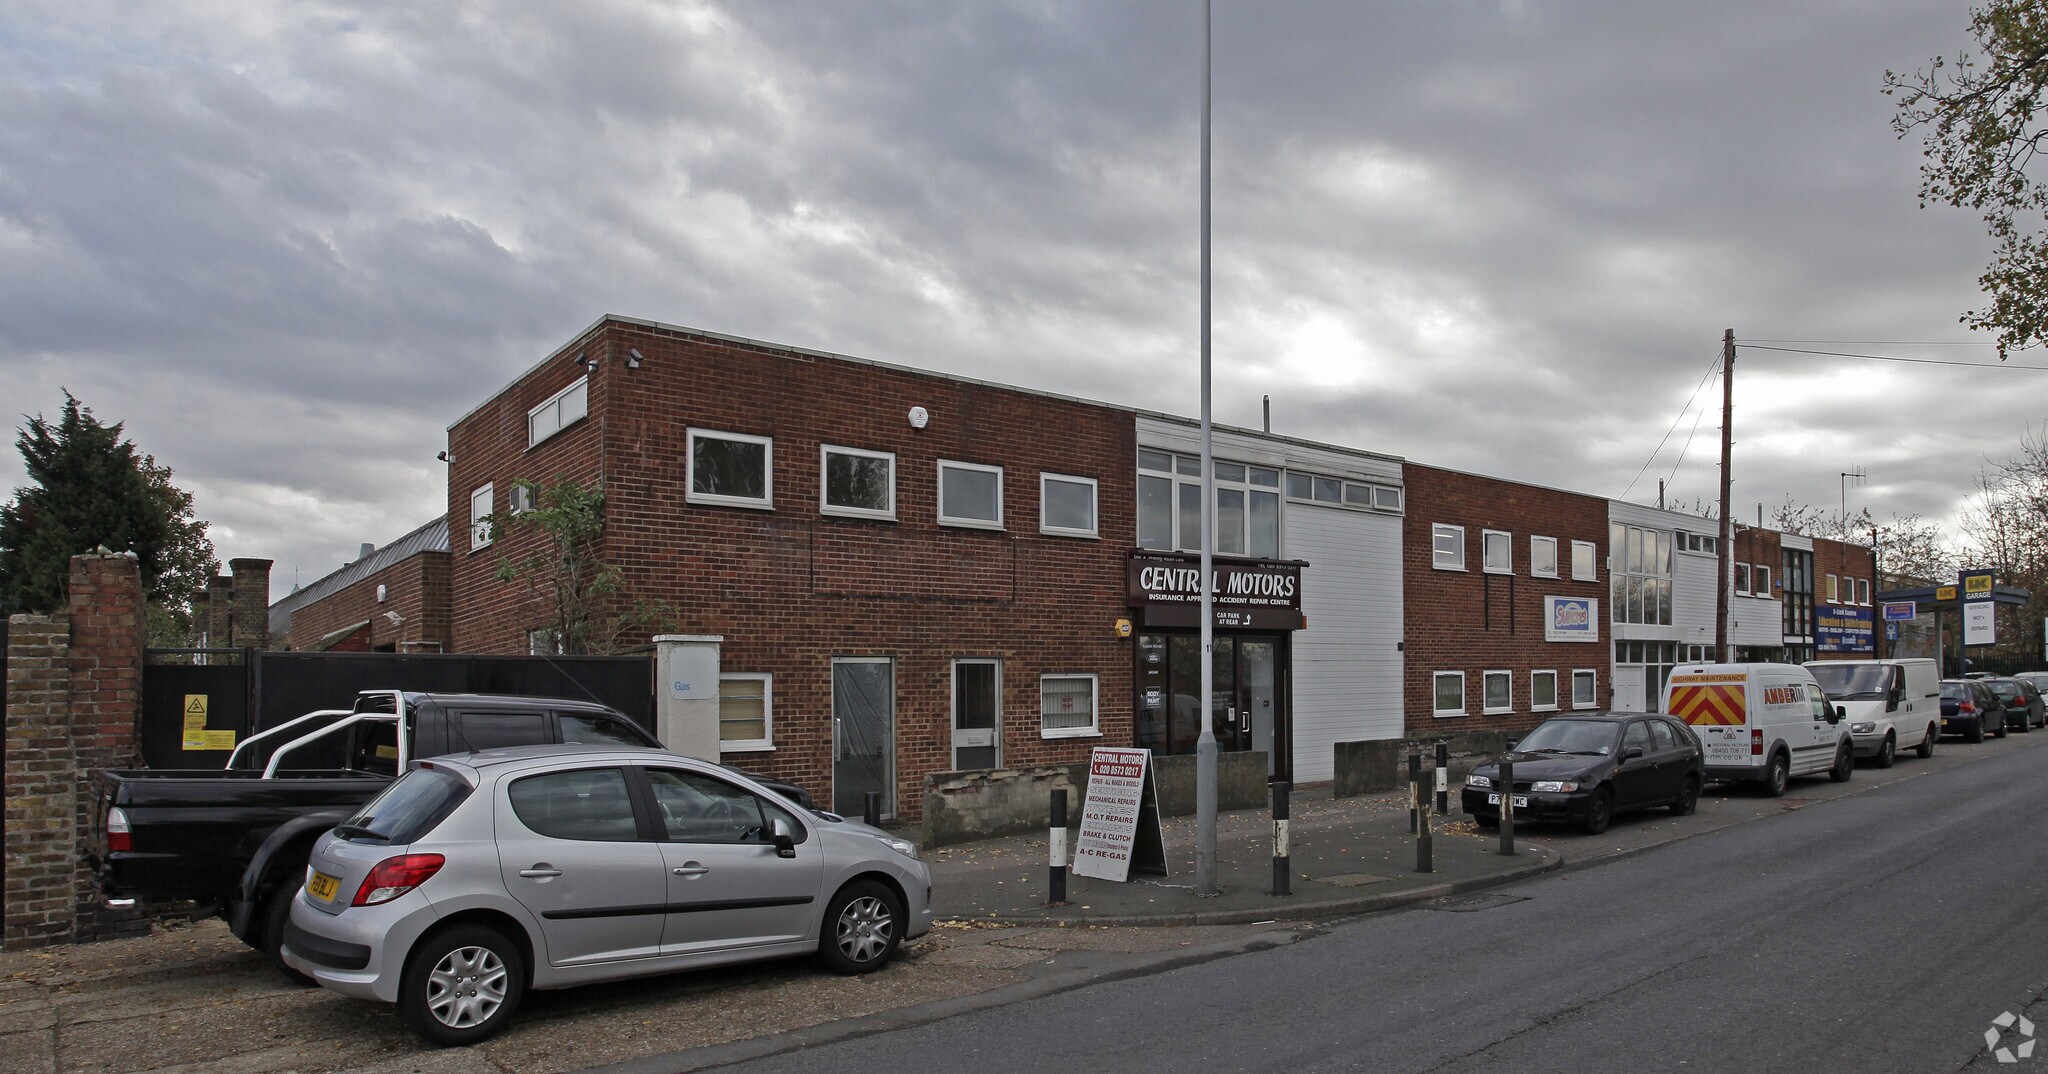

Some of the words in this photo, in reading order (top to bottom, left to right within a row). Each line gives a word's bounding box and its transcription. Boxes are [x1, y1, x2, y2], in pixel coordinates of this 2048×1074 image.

[1140, 567, 1220, 593] CENTRL
[1227, 572, 1295, 597] MOTORS
[675, 681, 690, 690] Gas
[1094, 753, 1118, 763] CENTRAL
[1120, 754, 1143, 765] MOTORS
[1100, 765, 1110, 774] 020
[1111, 766, 1124, 775] 8573
[1125, 766, 1139, 776] 0217
[1090, 786, 1137, 797] SERVICING
[1088, 804, 1135, 815] TYRES
[1106, 815, 1133, 824] REPAIRS
[1085, 821, 1132, 833] EXHAUSTS
[1083, 830, 1101, 839] BRAKE
[1108, 834, 1131, 842] CLUTCH
[1096, 851, 1127, 860] RE-GAS
